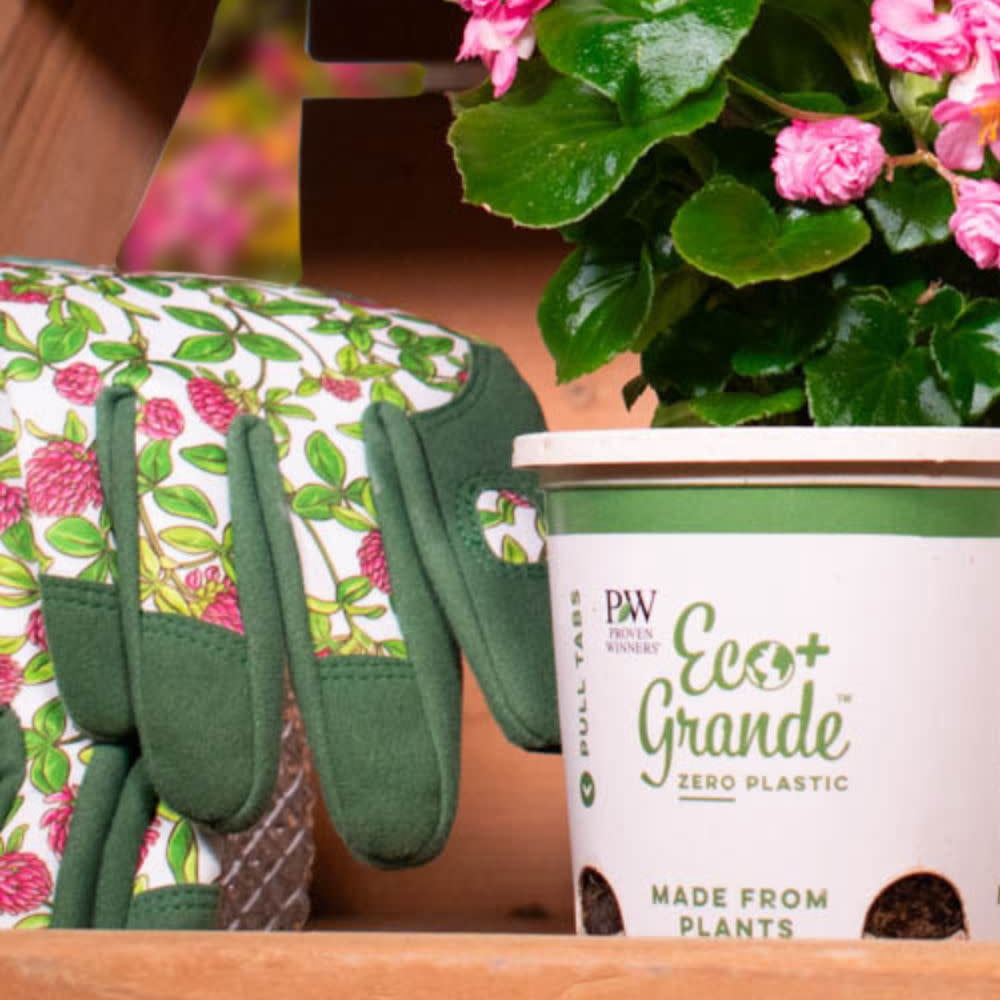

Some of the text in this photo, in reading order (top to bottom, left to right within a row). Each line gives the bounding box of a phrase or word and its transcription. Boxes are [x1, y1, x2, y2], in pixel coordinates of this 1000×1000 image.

[605, 589, 657, 624] PW
[569, 589, 590, 758] PULL TABS
[677, 773, 850, 792] ZERO PLASTIC
[651, 884, 828, 909] MADE FROM
[680, 915, 793, 939] PLANTS
